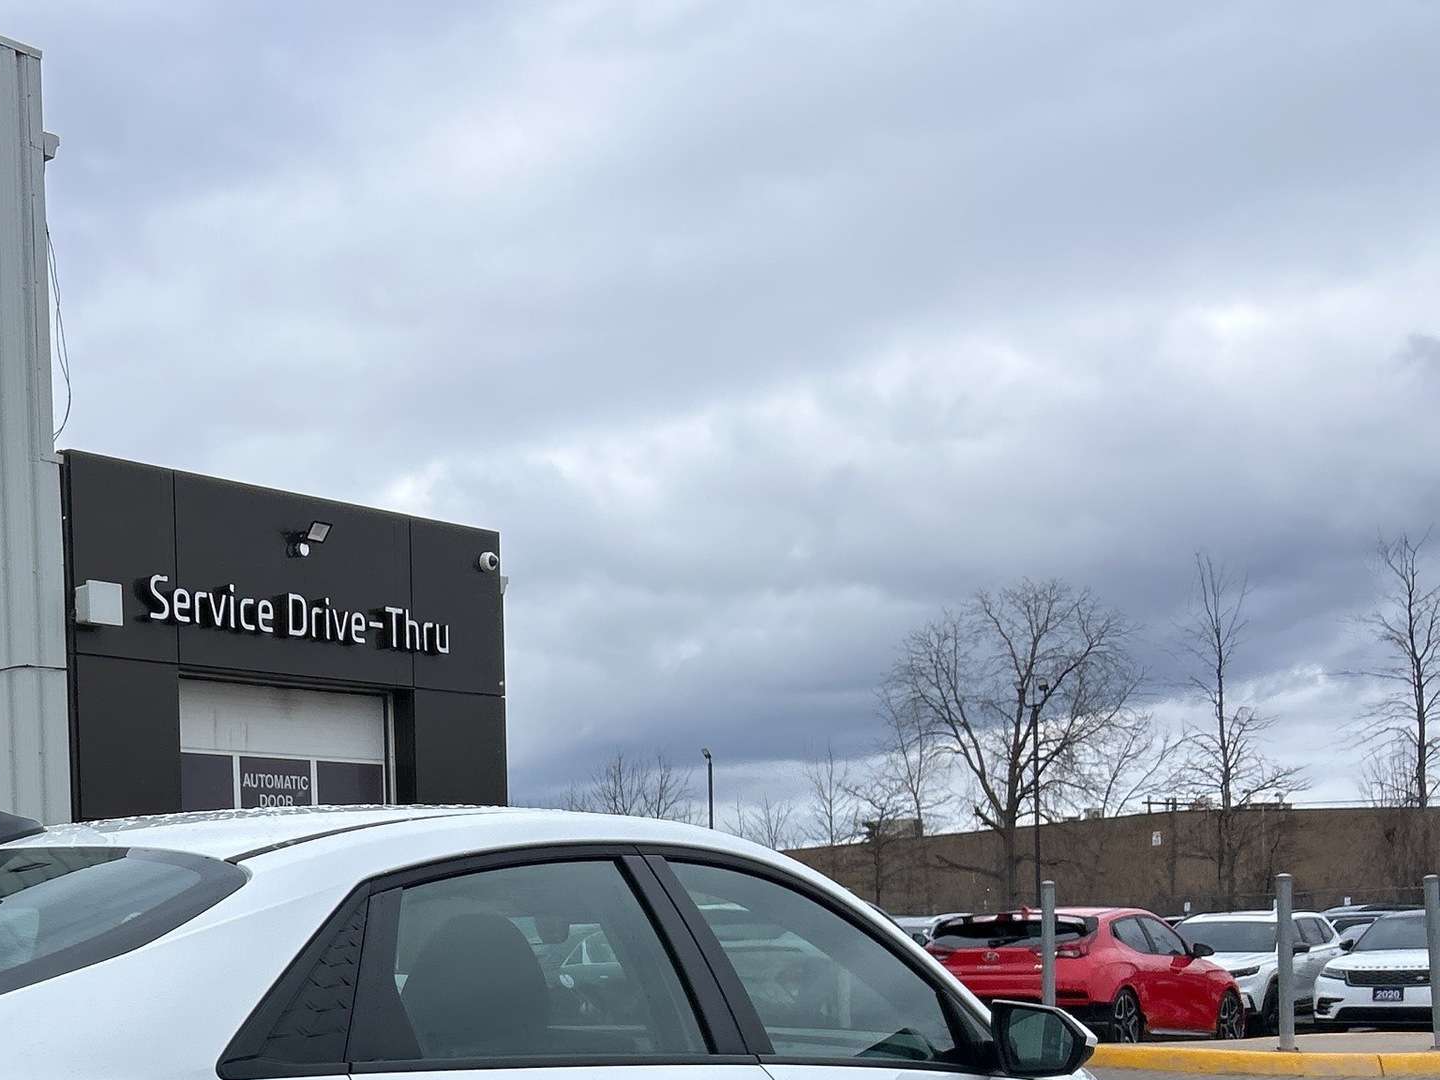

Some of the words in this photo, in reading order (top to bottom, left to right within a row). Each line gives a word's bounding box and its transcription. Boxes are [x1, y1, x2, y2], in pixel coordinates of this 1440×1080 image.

[149, 574, 274, 634] Service
[288, 592, 450, 655] Drive-Thru
[242, 772, 309, 791] AUTOMATIC
[259, 793, 294, 808] DOOR
[1374, 990, 1401, 1000] 2020
